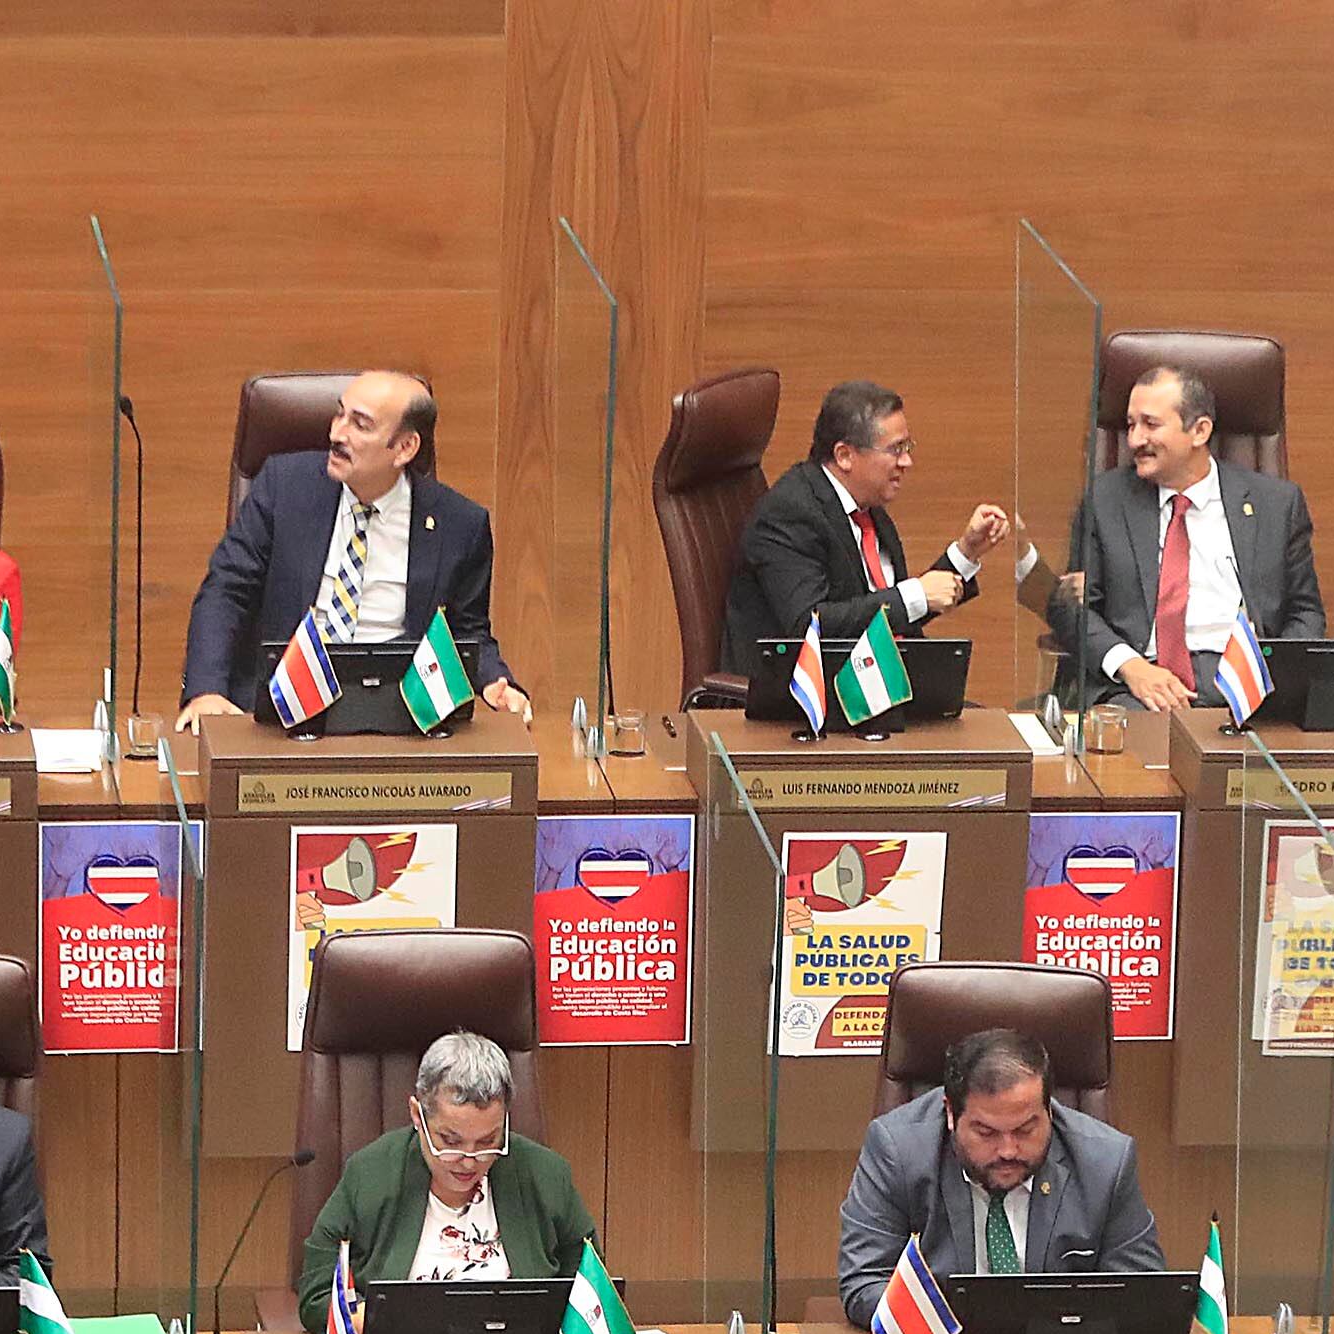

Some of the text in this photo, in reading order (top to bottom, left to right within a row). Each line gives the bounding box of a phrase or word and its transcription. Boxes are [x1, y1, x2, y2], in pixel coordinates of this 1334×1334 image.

[286, 784, 309, 799] JOSÉ
[312, 786, 369, 798] FRANCISCO
[418, 785, 471, 796] ALVARADO
[782, 783, 803, 794] LUIS
[806, 782, 861, 794] FERNANDO
[864, 782, 915, 794] MENDOZA
[549, 917, 675, 933] Yo defiendo la
[1036, 914, 1160, 928] Yo defiendo la
[550, 934, 676, 954] Educación
[808, 935, 910, 948] LA SALUD
[1036, 931, 1160, 950] Educación
[796, 949, 887, 967] PÚBLICA
[550, 955, 676, 981] Pública
[803, 974, 829, 986] DE
